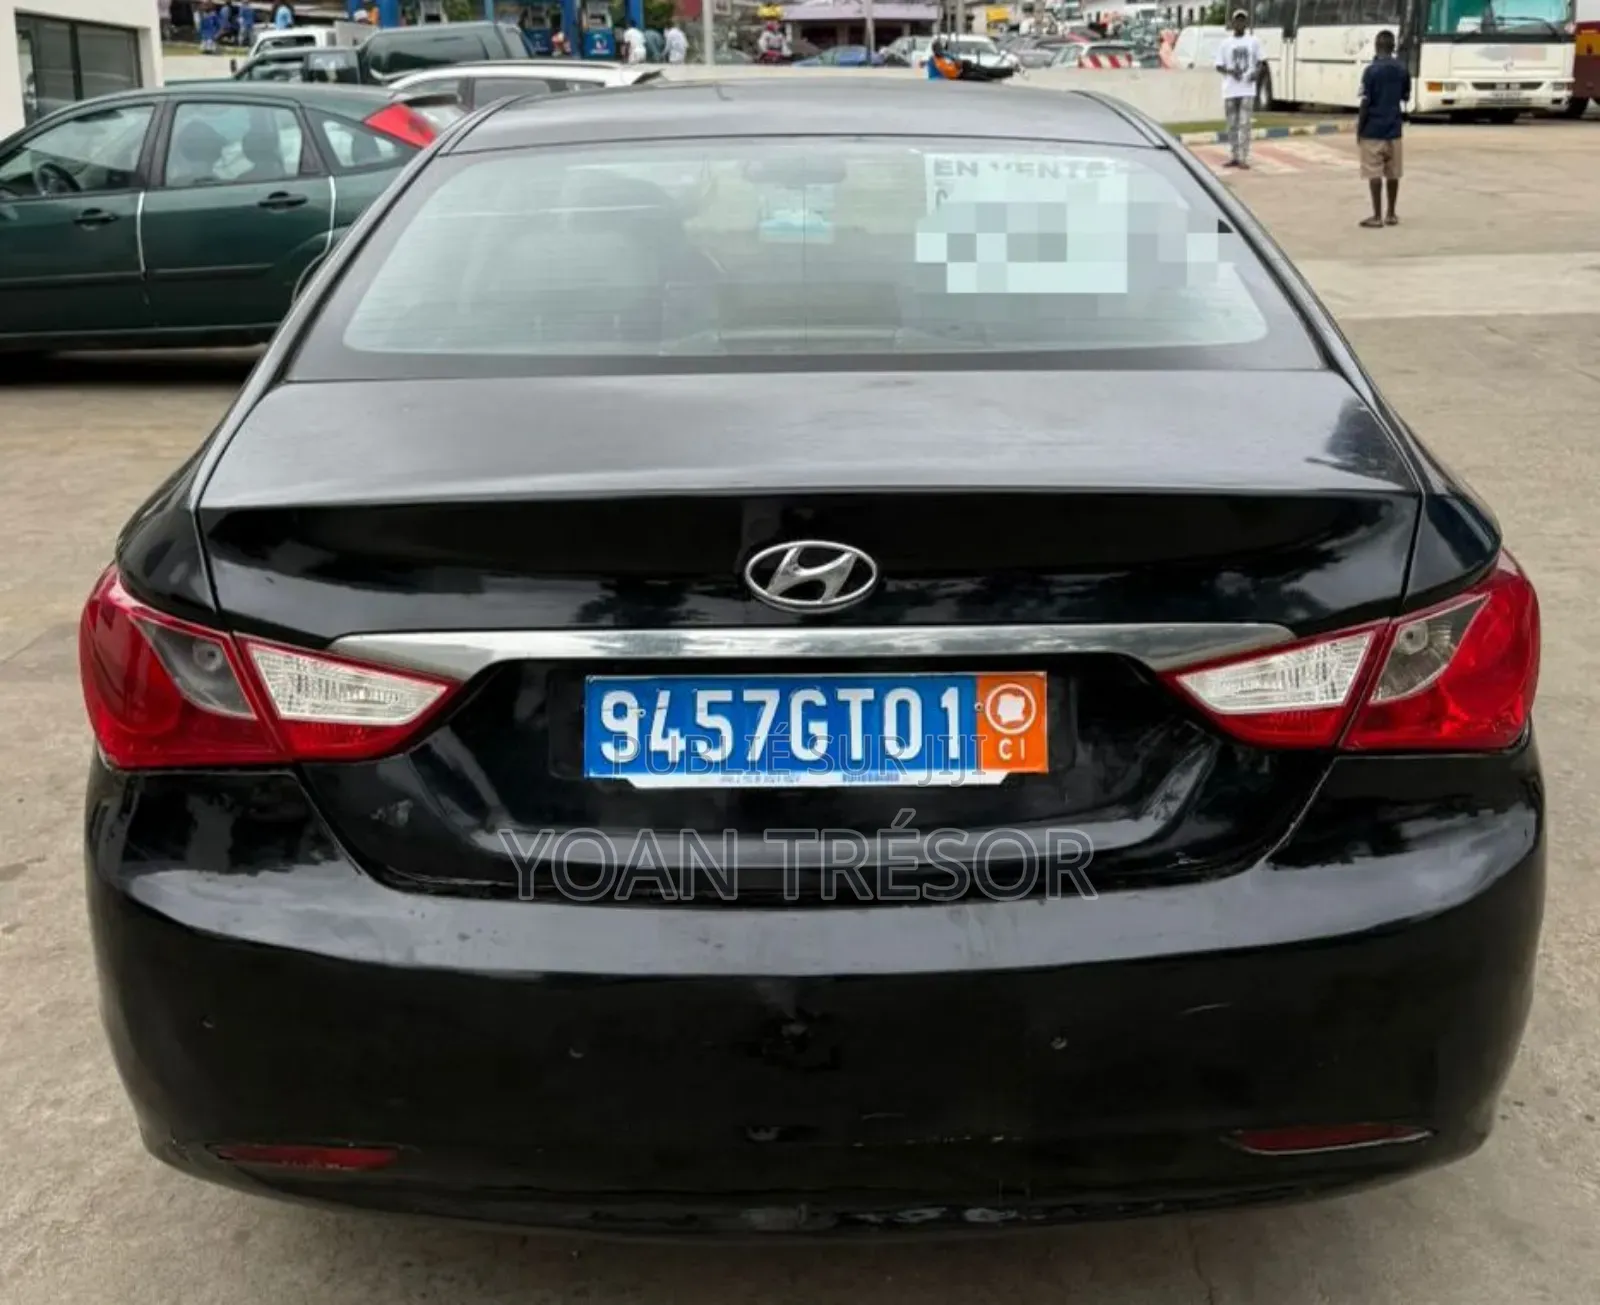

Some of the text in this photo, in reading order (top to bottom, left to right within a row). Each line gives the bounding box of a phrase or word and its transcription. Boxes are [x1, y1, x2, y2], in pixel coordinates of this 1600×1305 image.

[934, 159, 977, 177] EN
[600, 687, 962, 762] 9457GT01
[998, 738, 1026, 760] CI
